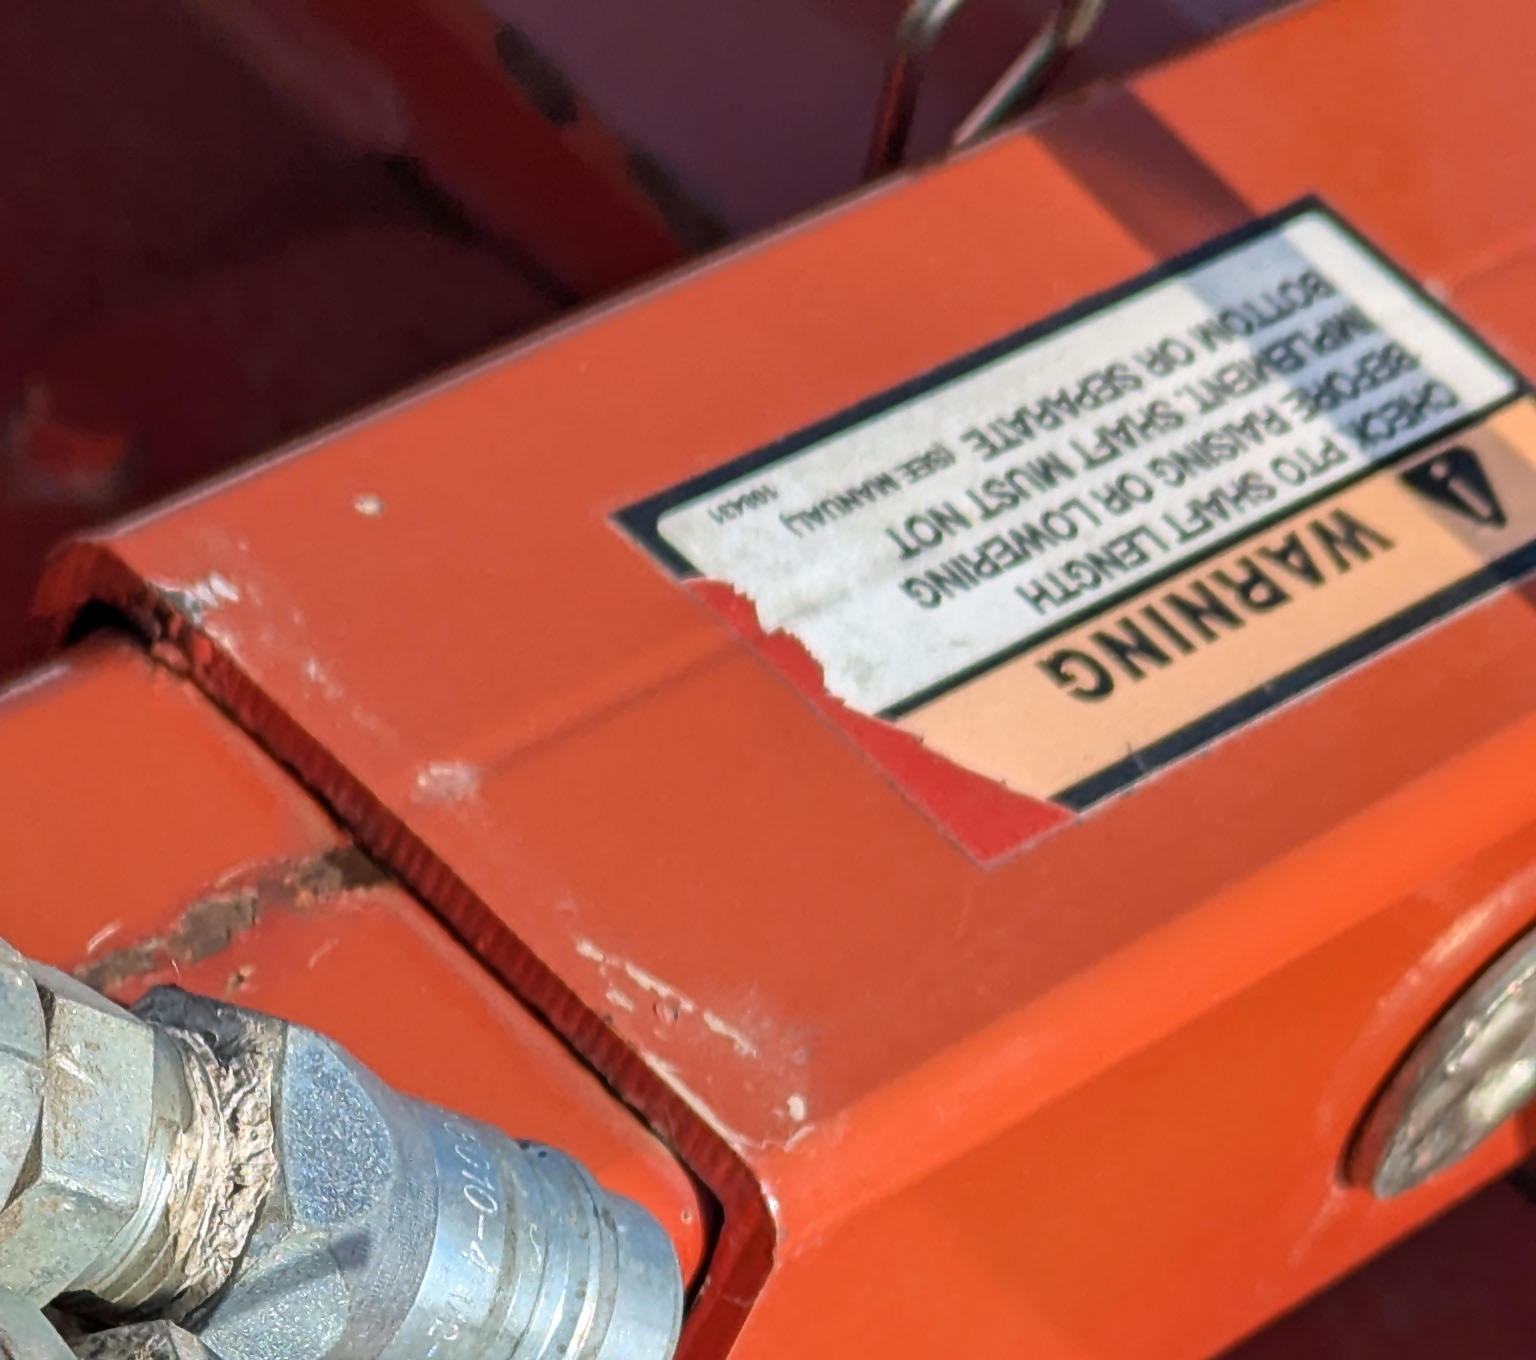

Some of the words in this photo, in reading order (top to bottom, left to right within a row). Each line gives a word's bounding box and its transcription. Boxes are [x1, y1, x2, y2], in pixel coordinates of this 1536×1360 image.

[1188, 269, 1337, 353] BOTTOM
[1134, 337, 1195, 376] OR
[1281, 342, 1421, 422] BEFORE
[960, 363, 1143, 461] SEPARATE
[1069, 400, 1185, 469] SHAFT
[1148, 406, 1291, 488] RAISING
[1353, 379, 1459, 448] CHECK
[966, 451, 1076, 522] MUST
[1092, 473, 1154, 517] OR
[1270, 436, 1349, 487] PTO
[778, 472, 901, 536] MANUAL)
[885, 501, 972, 561] NOT
[1162, 471, 1277, 543] SHAFT
[899, 498, 1102, 609] LOWERING
[1015, 525, 1170, 615] LENGTH
[1035, 507, 1397, 703] WARNING
